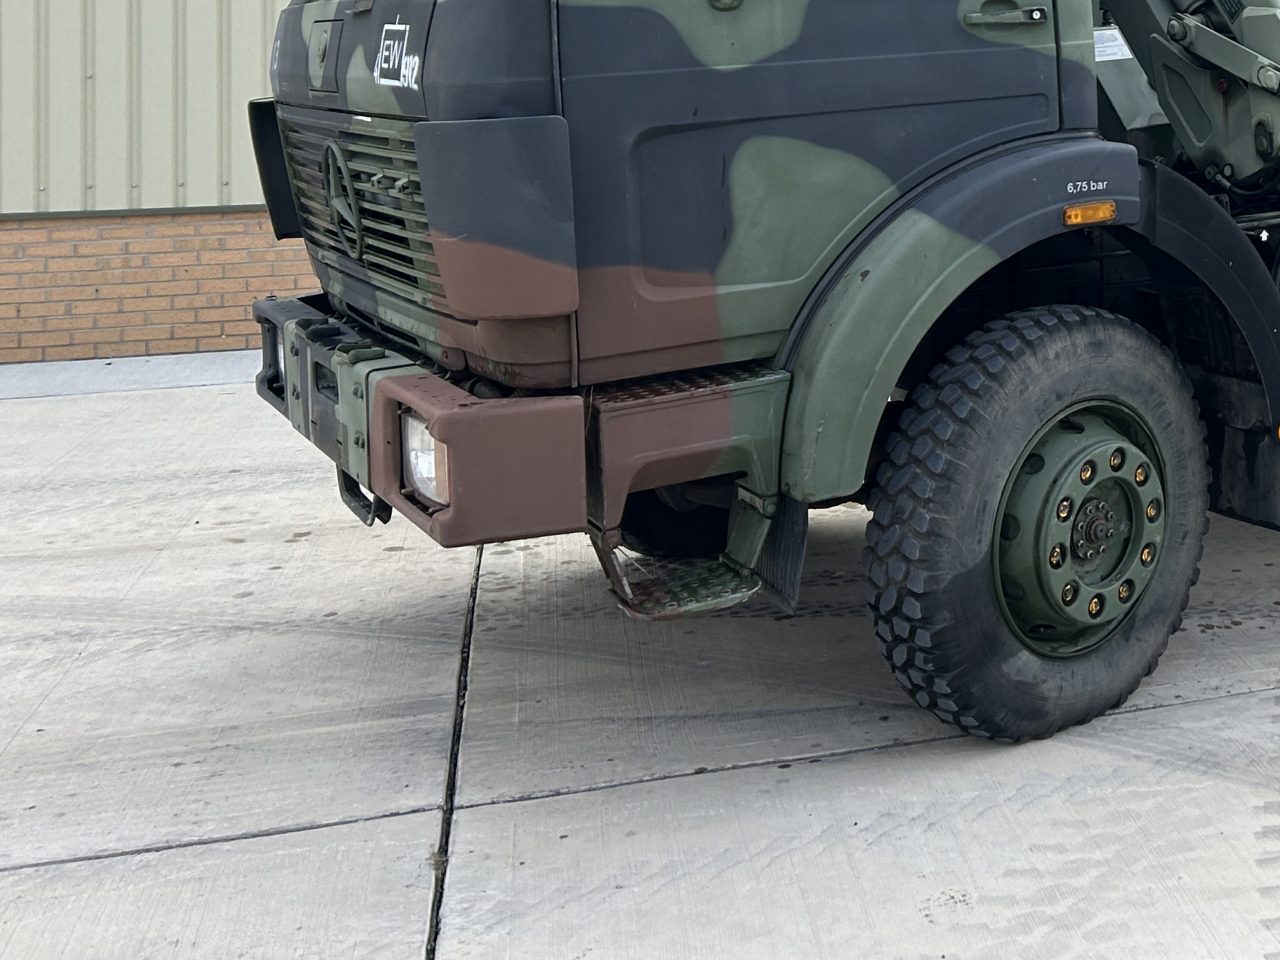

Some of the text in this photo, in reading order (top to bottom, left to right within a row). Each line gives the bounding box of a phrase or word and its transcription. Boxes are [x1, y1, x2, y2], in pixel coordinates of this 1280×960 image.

[381, 39, 403, 69] EW
[1067, 180, 1108, 194] 6,75 bar
